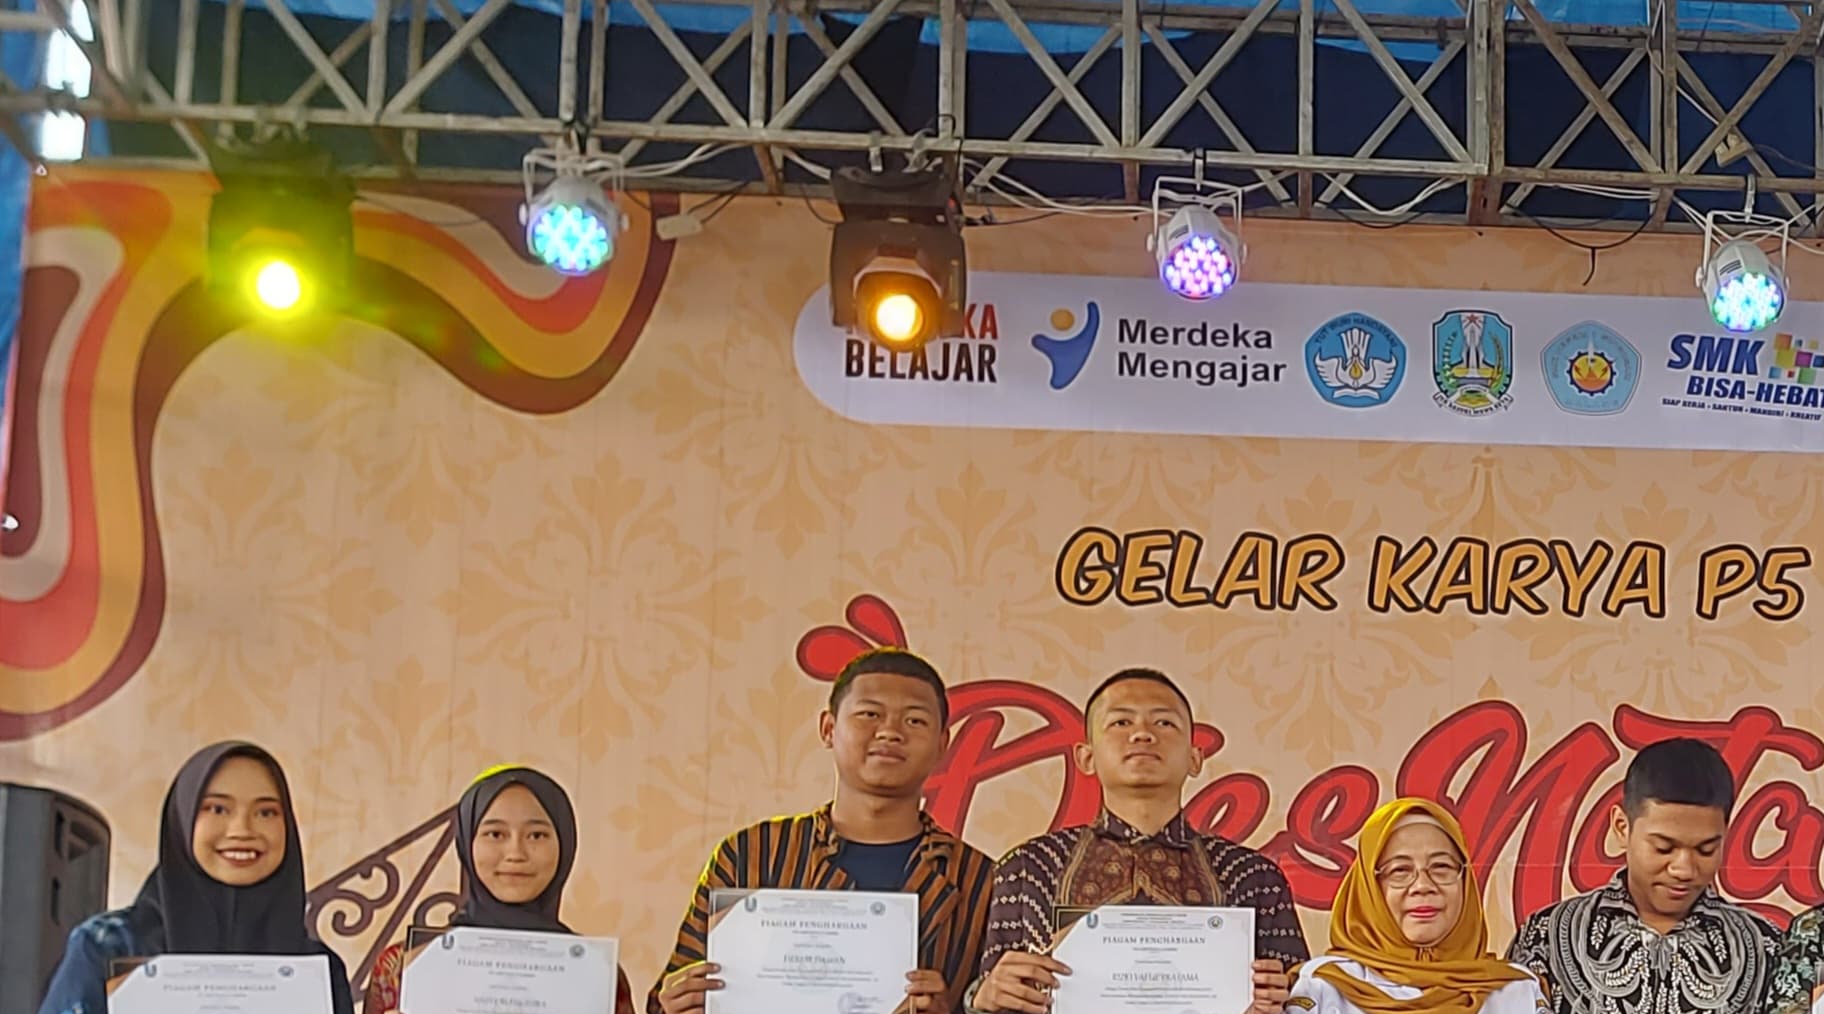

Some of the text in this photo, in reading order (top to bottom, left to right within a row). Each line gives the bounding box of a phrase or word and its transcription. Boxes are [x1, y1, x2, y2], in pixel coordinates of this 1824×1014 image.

[1117, 317, 1274, 350] Merdeka
[845, 338, 998, 383] BELAJAR
[1117, 351, 1288, 387] Mengajar
[1667, 334, 1765, 376] SMK
[1054, 527, 1345, 613] GELAR
[1367, 536, 1667, 620] KARYA
[1695, 544, 1811, 621] P5
